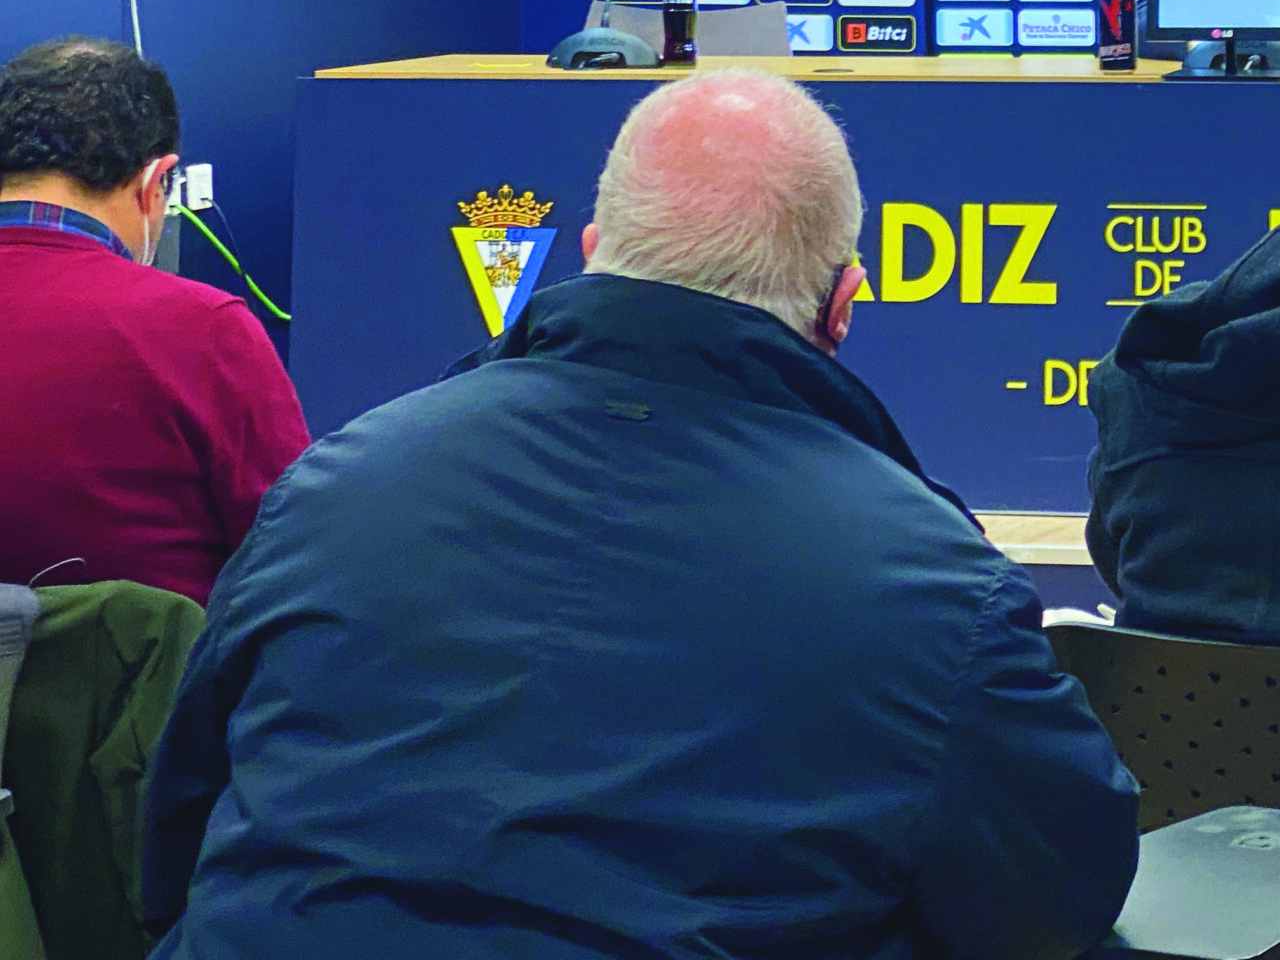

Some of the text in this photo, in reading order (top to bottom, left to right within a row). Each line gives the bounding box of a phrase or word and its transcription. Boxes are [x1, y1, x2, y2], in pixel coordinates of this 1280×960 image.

[867, 25, 908, 41] Bitci
[1221, 29, 1234, 38] LG
[853, 202, 1057, 306] DIZ
[1104, 216, 1207, 255] CLUB
[1134, 260, 1183, 297] DE
